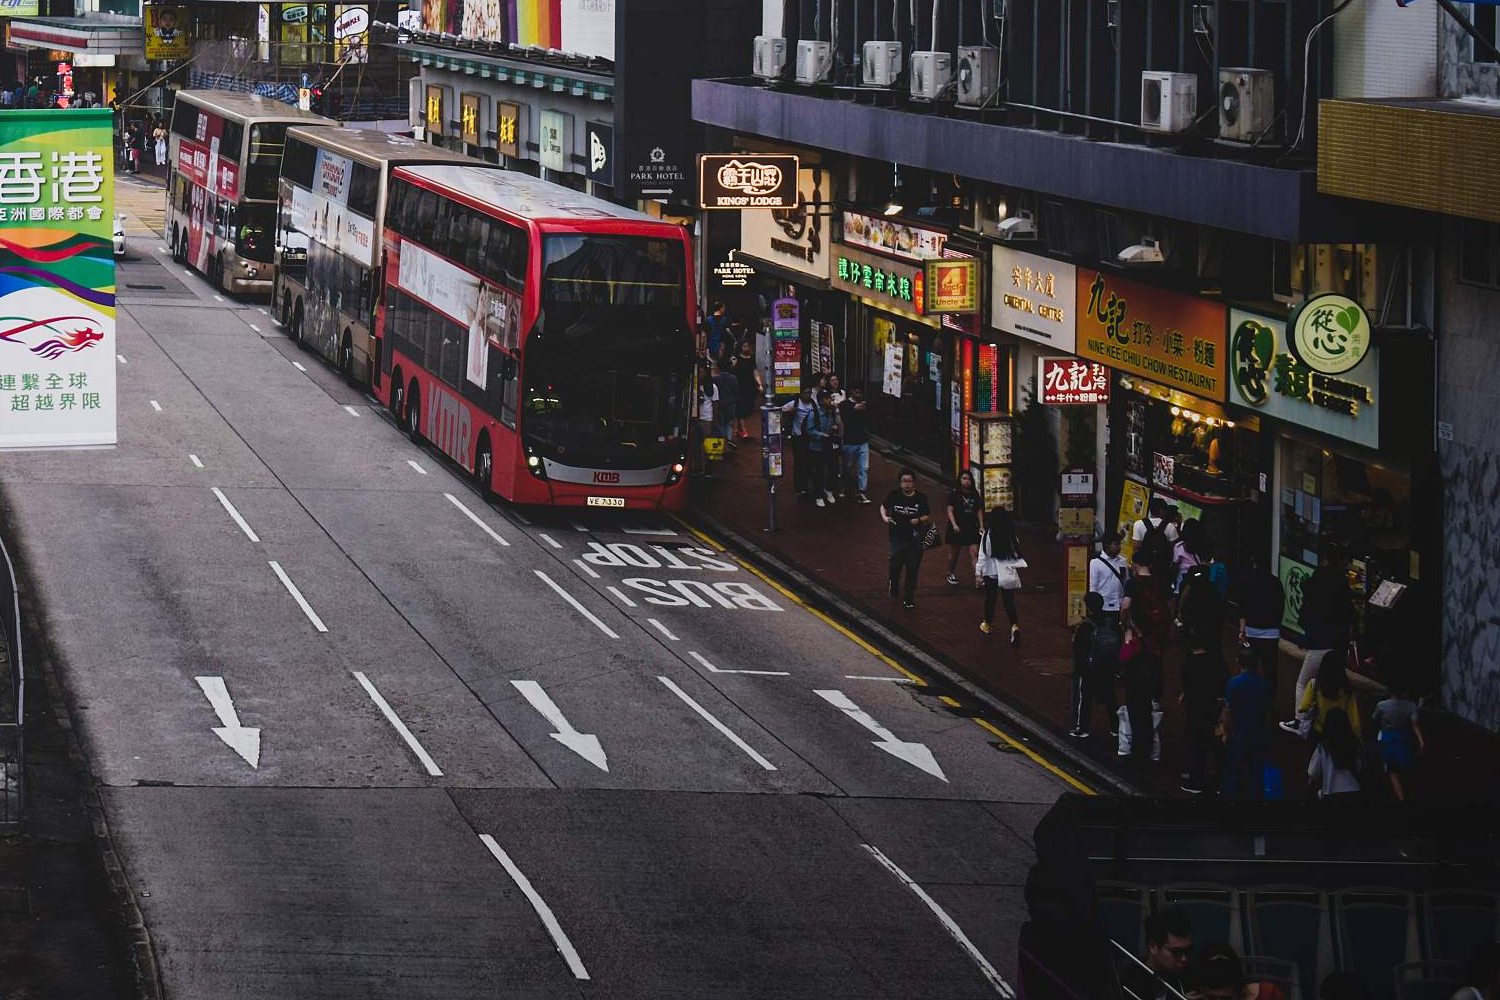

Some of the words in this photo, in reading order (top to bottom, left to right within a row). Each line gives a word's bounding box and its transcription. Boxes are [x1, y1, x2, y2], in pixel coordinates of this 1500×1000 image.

[750, 197, 782, 205] LODGE
[839, 258, 910, 300] 譚仔雲南米線
[1039, 305, 1064, 322] CENTRE
[1087, 272, 1130, 345] 九記
[1351, 333, 1360, 357] 素食
[1046, 362, 1091, 391] 九記
[1088, 339, 1105, 356] NINE
[1107, 344, 1121, 360] KEE
[1123, 349, 1140, 366] CHIU
[1142, 356, 1166, 374] CHOW
[1168, 364, 1217, 393] RESTAURNT
[11, 393, 101, 411] 超越界限
[427, 381, 472, 472] KMB
[594, 472, 620, 483] KMB
[582, 542, 739, 572] STOP
[622, 578, 784, 611] BUS
